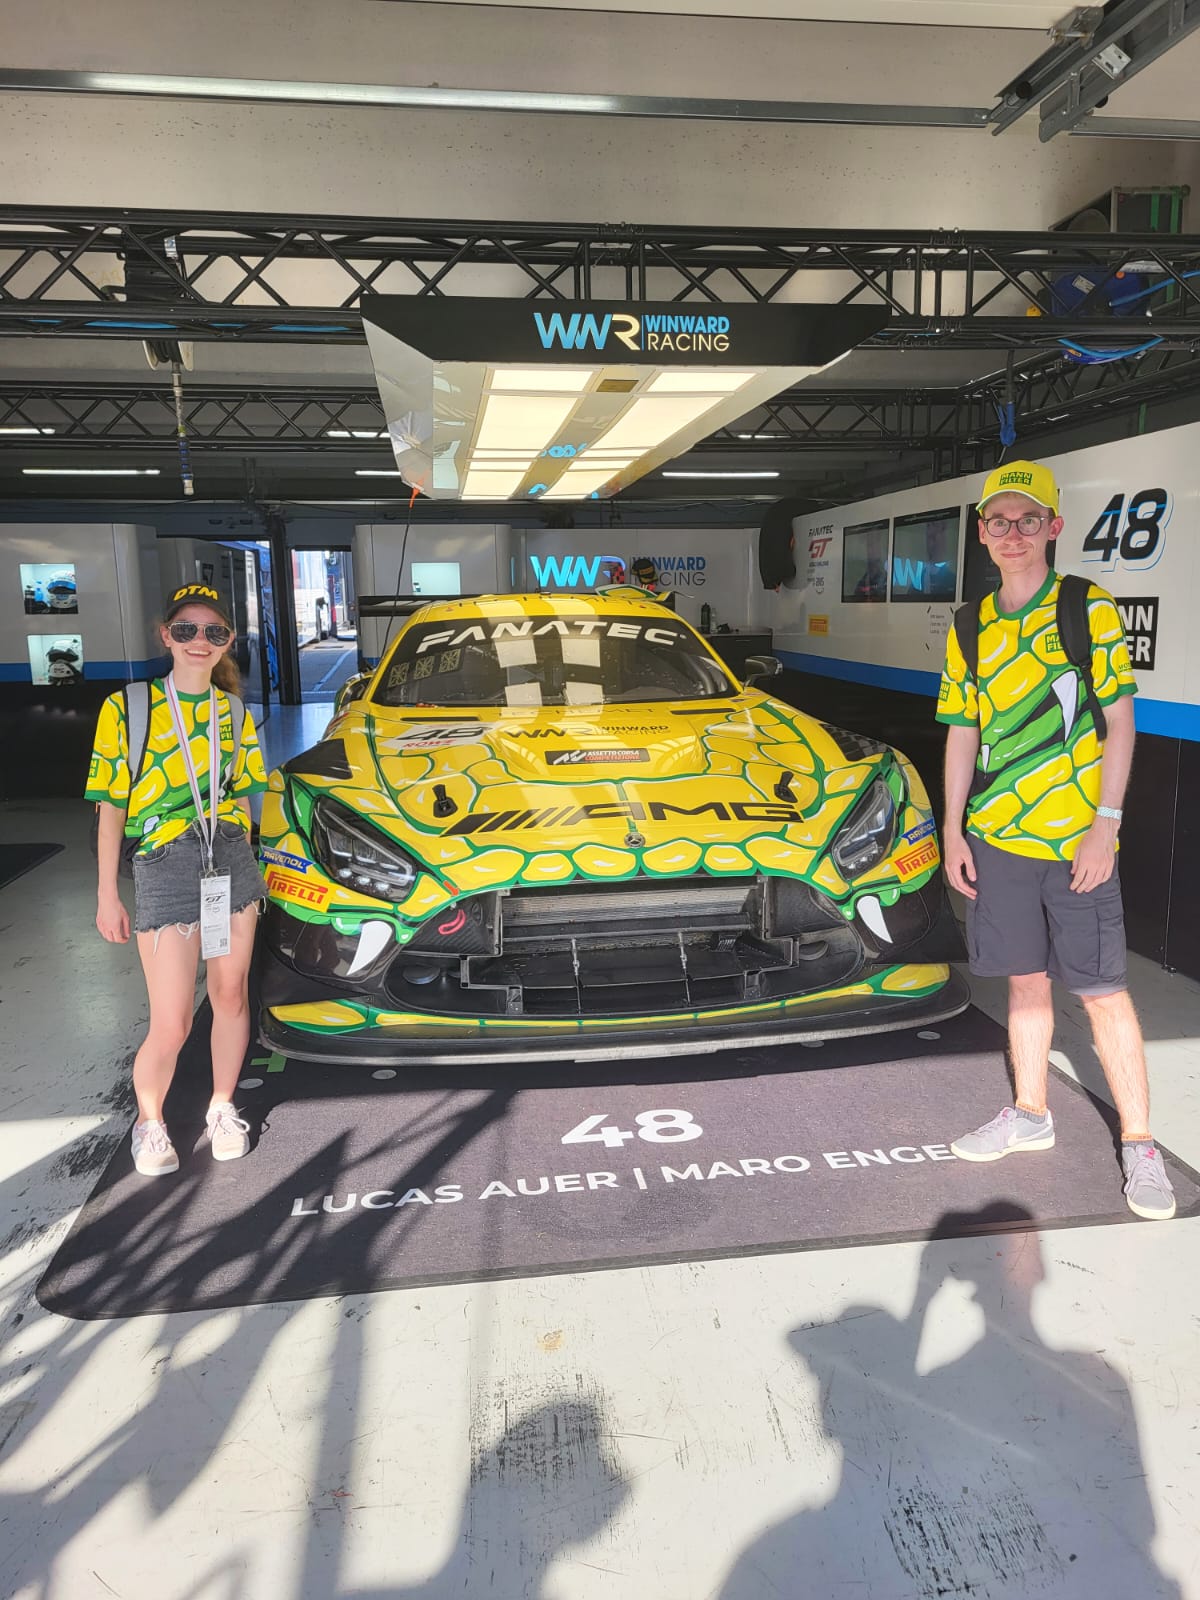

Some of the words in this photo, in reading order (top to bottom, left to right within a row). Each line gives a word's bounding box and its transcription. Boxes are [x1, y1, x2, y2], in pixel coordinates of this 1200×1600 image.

[645, 315, 730, 333] WINWARD
[647, 333, 730, 352] RACING
[1082, 487, 1168, 562] 48
[173, 584, 218, 601] DTM
[416, 620, 678, 654] FANATEC
[263, 850, 306, 871] RAVENOL
[894, 841, 938, 875] PIRELLI
[267, 871, 328, 904] PIRELLI
[561, 1109, 704, 1148] 48
[290, 1183, 465, 1217] LUCAS
[479, 1169, 621, 1199] AUER
[660, 1152, 811, 1182] MARO
[823, 1141, 956, 1169] ENGE
